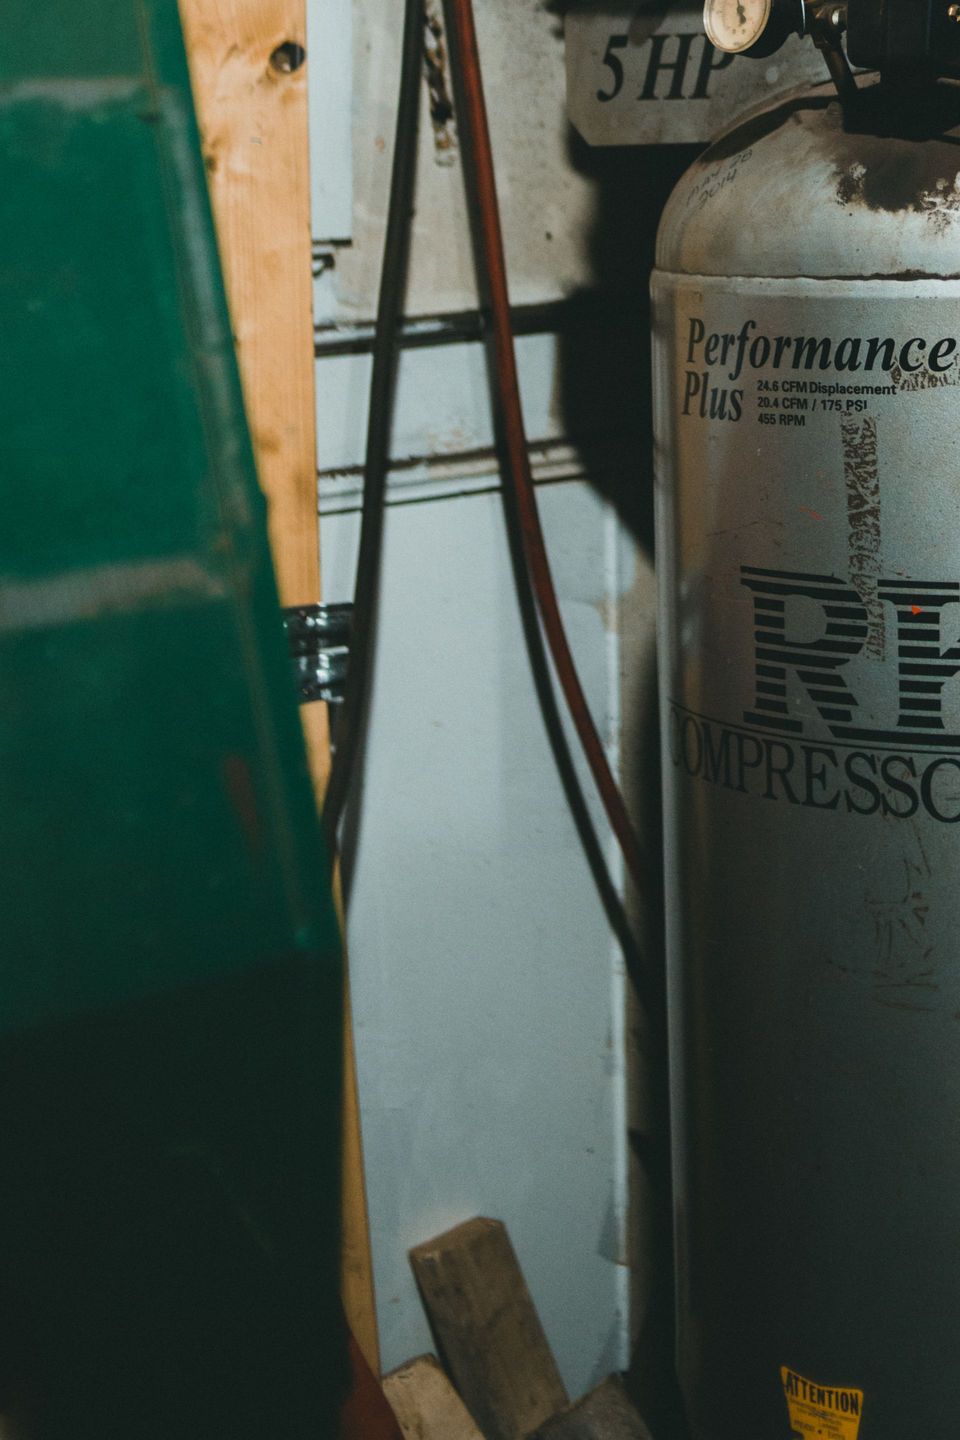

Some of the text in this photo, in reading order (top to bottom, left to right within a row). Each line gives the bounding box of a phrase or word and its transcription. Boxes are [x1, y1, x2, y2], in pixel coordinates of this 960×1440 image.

[597, 33, 737, 102] 5 HP
[686, 317, 957, 381] Performance
[682, 370, 744, 422] Plus
[757, 380, 897, 396] 24.6 CFM Displacement
[757, 396, 779, 409] 20.4
[781, 397, 808, 410] CFM
[820, 399, 842, 412] 175
[846, 399, 867, 412] PSI
[757, 413, 805, 426] 455 RPM
[786, 1371, 859, 1416] ATTENTION
